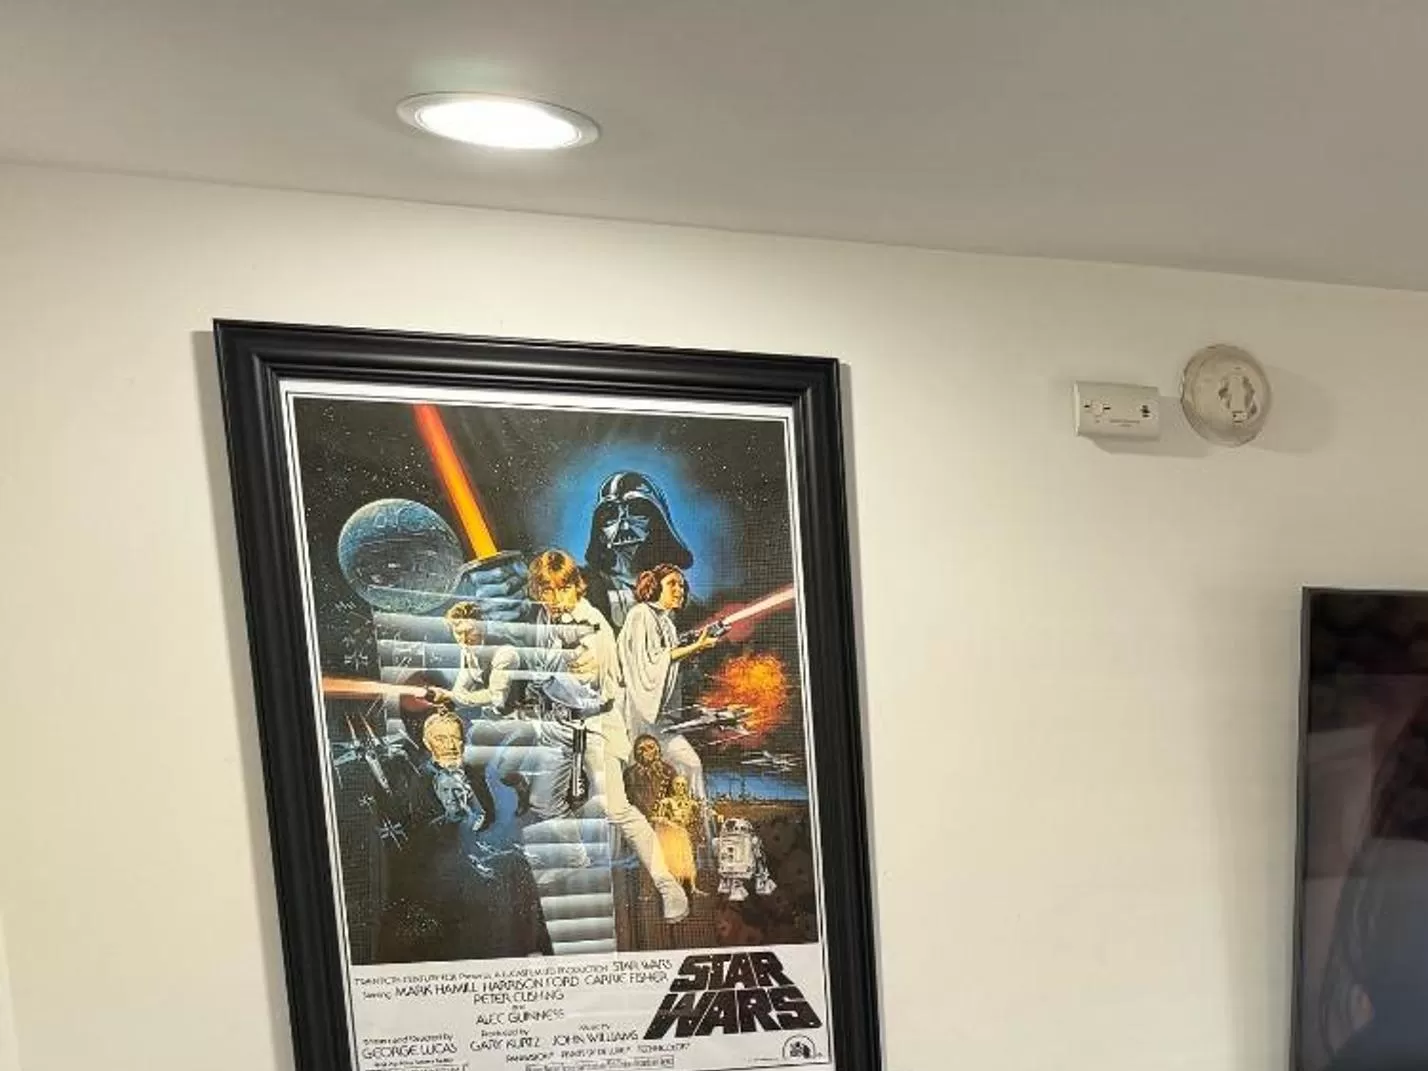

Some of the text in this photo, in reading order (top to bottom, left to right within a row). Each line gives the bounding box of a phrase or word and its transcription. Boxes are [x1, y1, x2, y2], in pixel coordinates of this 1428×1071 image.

[613, 960, 639, 972] STAR
[641, 959, 672, 970] WARS
[669, 951, 794, 992] STAR
[395, 984, 432, 996] MARK
[435, 982, 478, 995] HAMILL
[545, 975, 579, 987] FORD
[474, 989, 564, 1005] PETER CUSHING
[475, 1008, 564, 1025] ALEC GUINNESS
[643, 986, 823, 1040] WARS
[470, 1039, 504, 1051] GARY
[552, 1030, 639, 1047] JOHN WILLIAMS
[362, 1043, 458, 1060] GEORGE LUCAS
